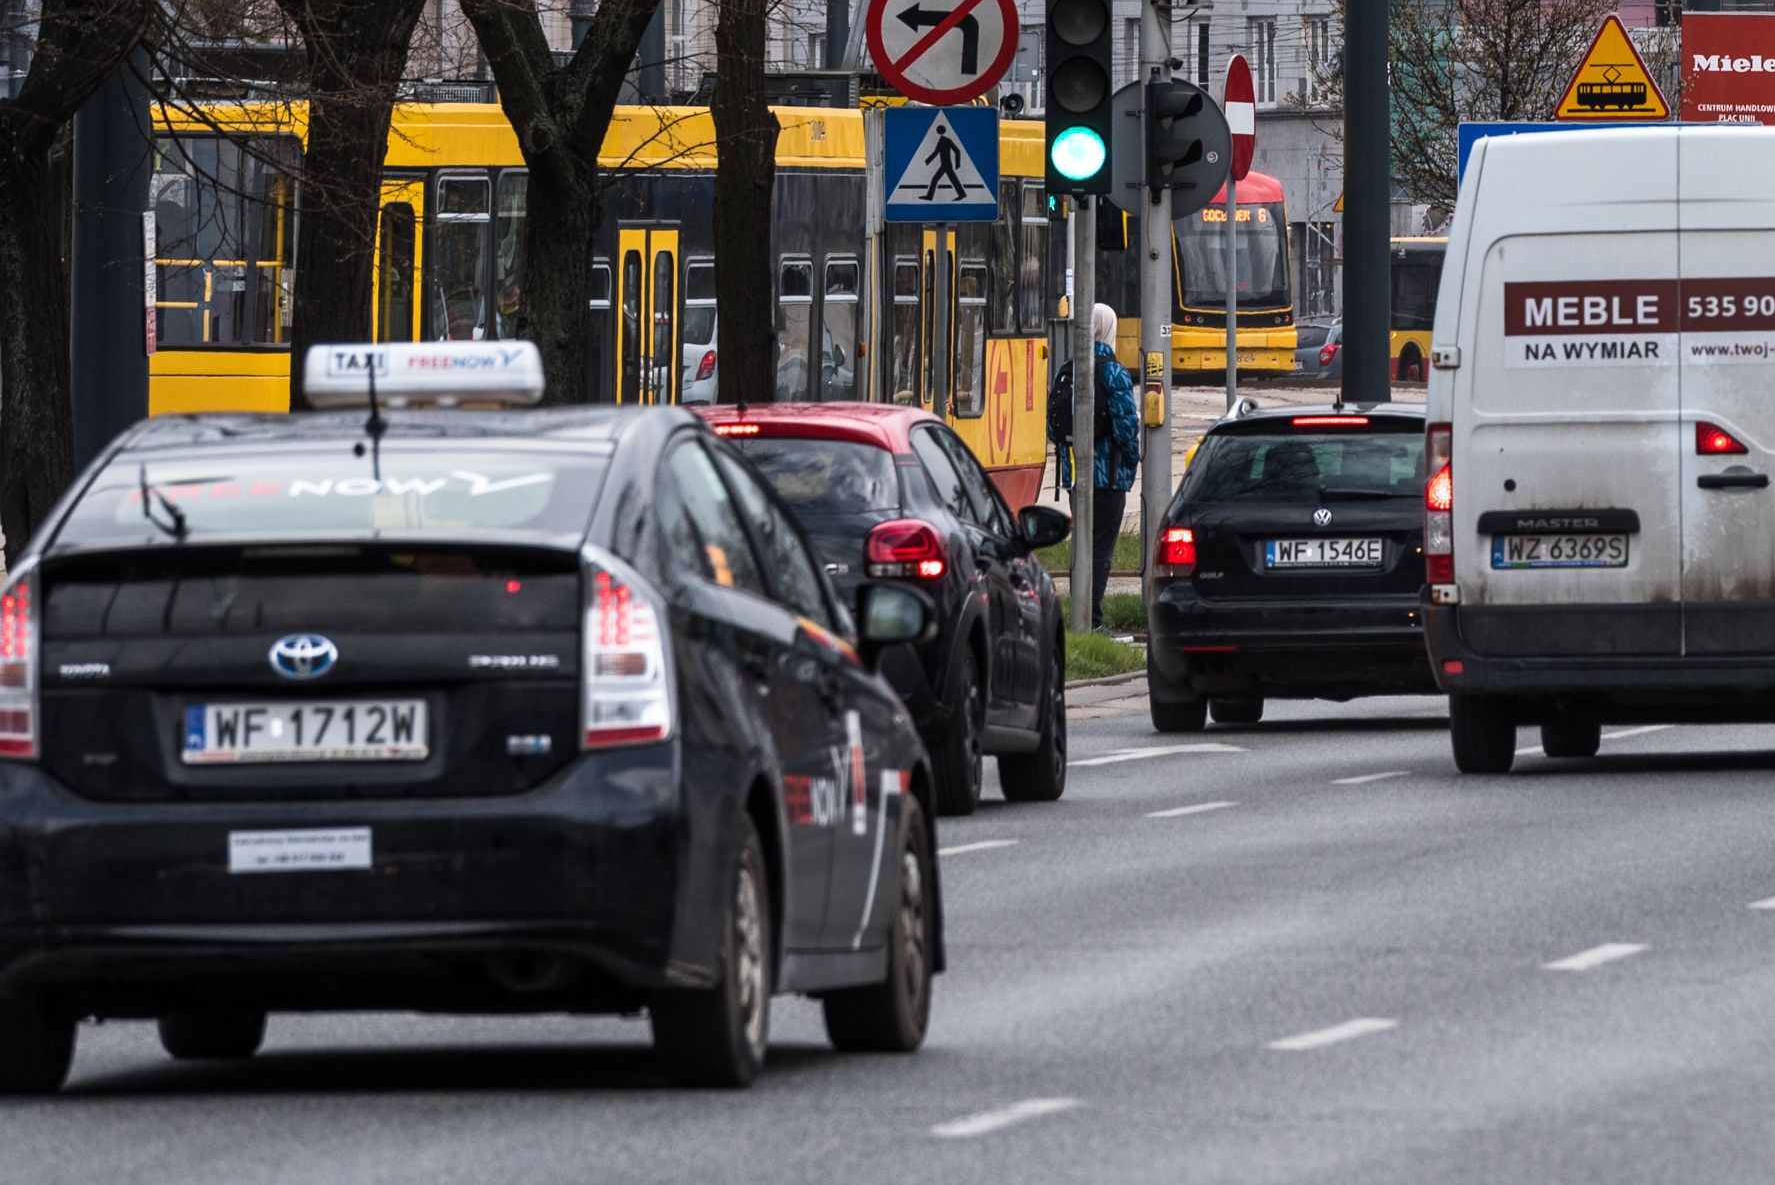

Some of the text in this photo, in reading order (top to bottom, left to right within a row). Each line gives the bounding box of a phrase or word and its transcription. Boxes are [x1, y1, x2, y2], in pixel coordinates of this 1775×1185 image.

[1697, 104, 1733, 112] CENTRUM
[1718, 114, 1738, 122] PLAC
[1524, 295, 1660, 327] MEBLE
[1687, 296, 1738, 318] 535
[333, 352, 384, 370] TAXI
[1524, 342, 1660, 361] NA WYMIAR
[1517, 518, 1599, 528] MASTER
[1279, 541, 1308, 561] WF
[1318, 540, 1380, 561] 1546E
[1509, 538, 1541, 561] WZ
[1549, 537, 1623, 560] 6369S
[215, 705, 416, 748] WF 1712W
